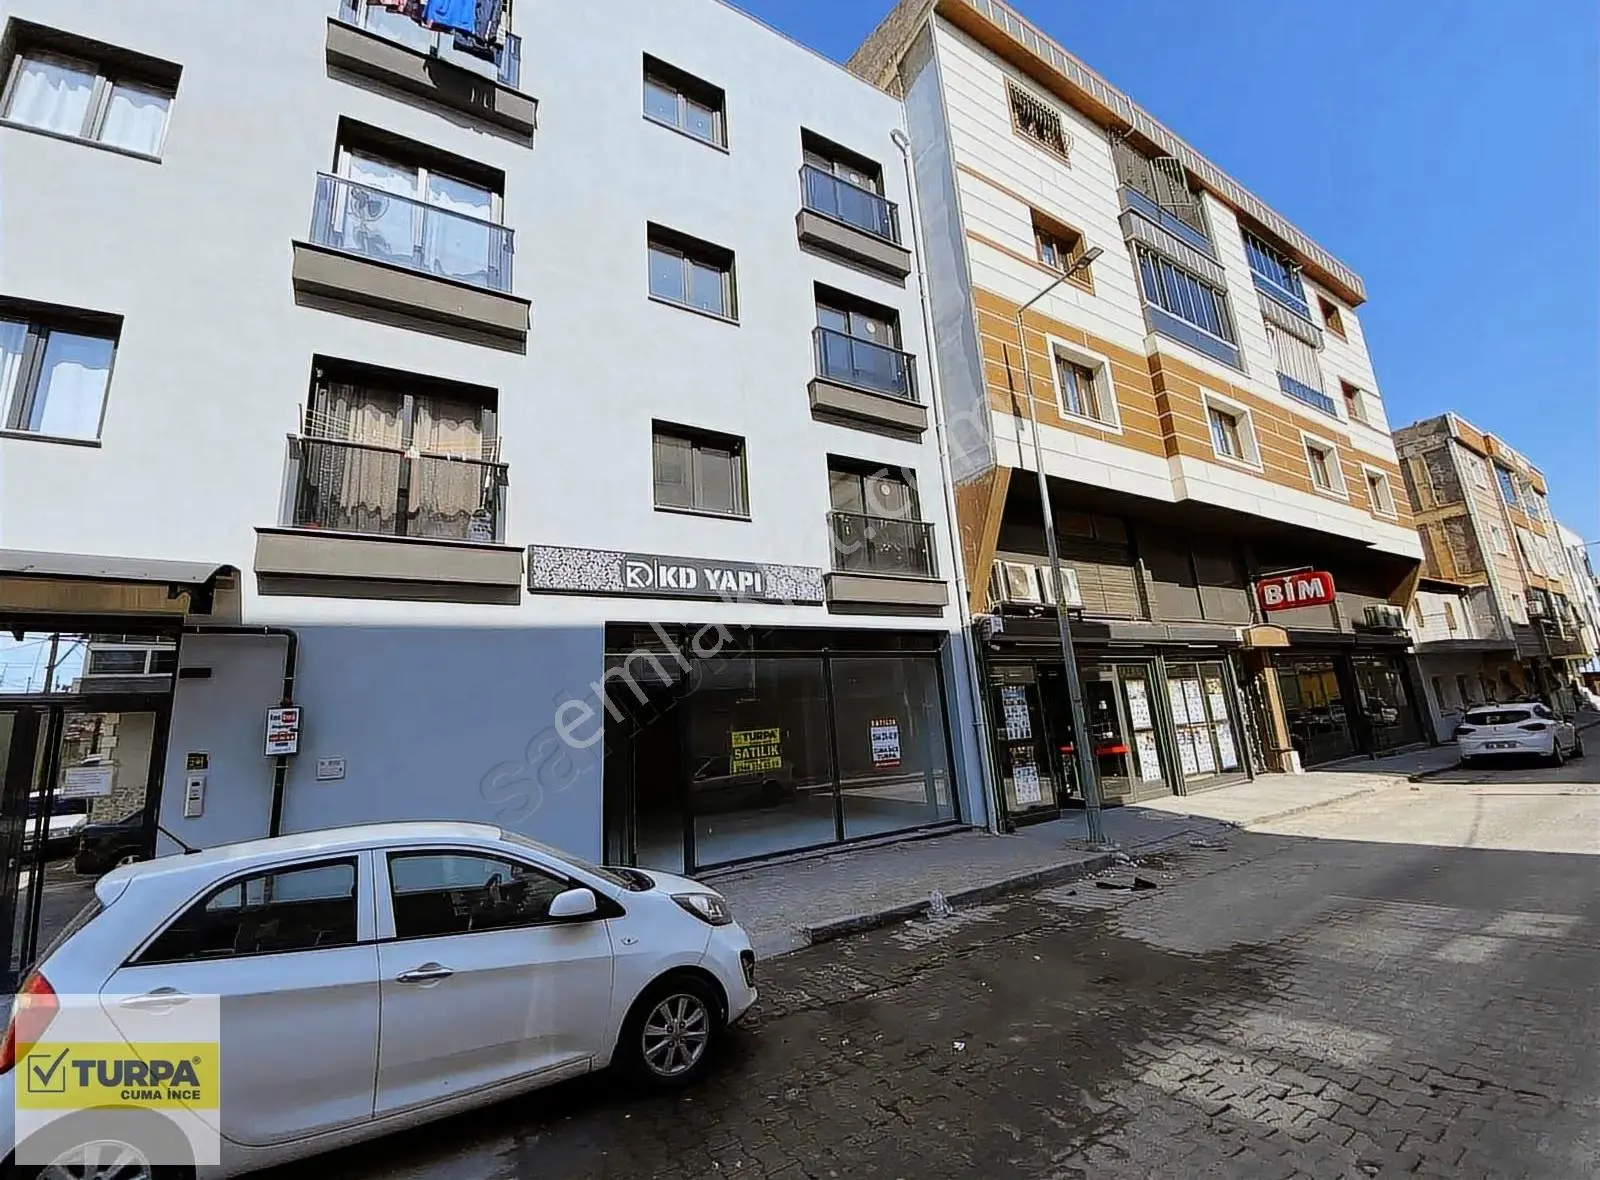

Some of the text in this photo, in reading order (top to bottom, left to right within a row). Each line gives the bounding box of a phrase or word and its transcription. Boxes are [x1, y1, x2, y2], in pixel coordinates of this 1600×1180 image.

[659, 564, 697, 590] KD
[703, 569, 763, 593] YAPI
[734, 744, 779, 760] SATILIK
